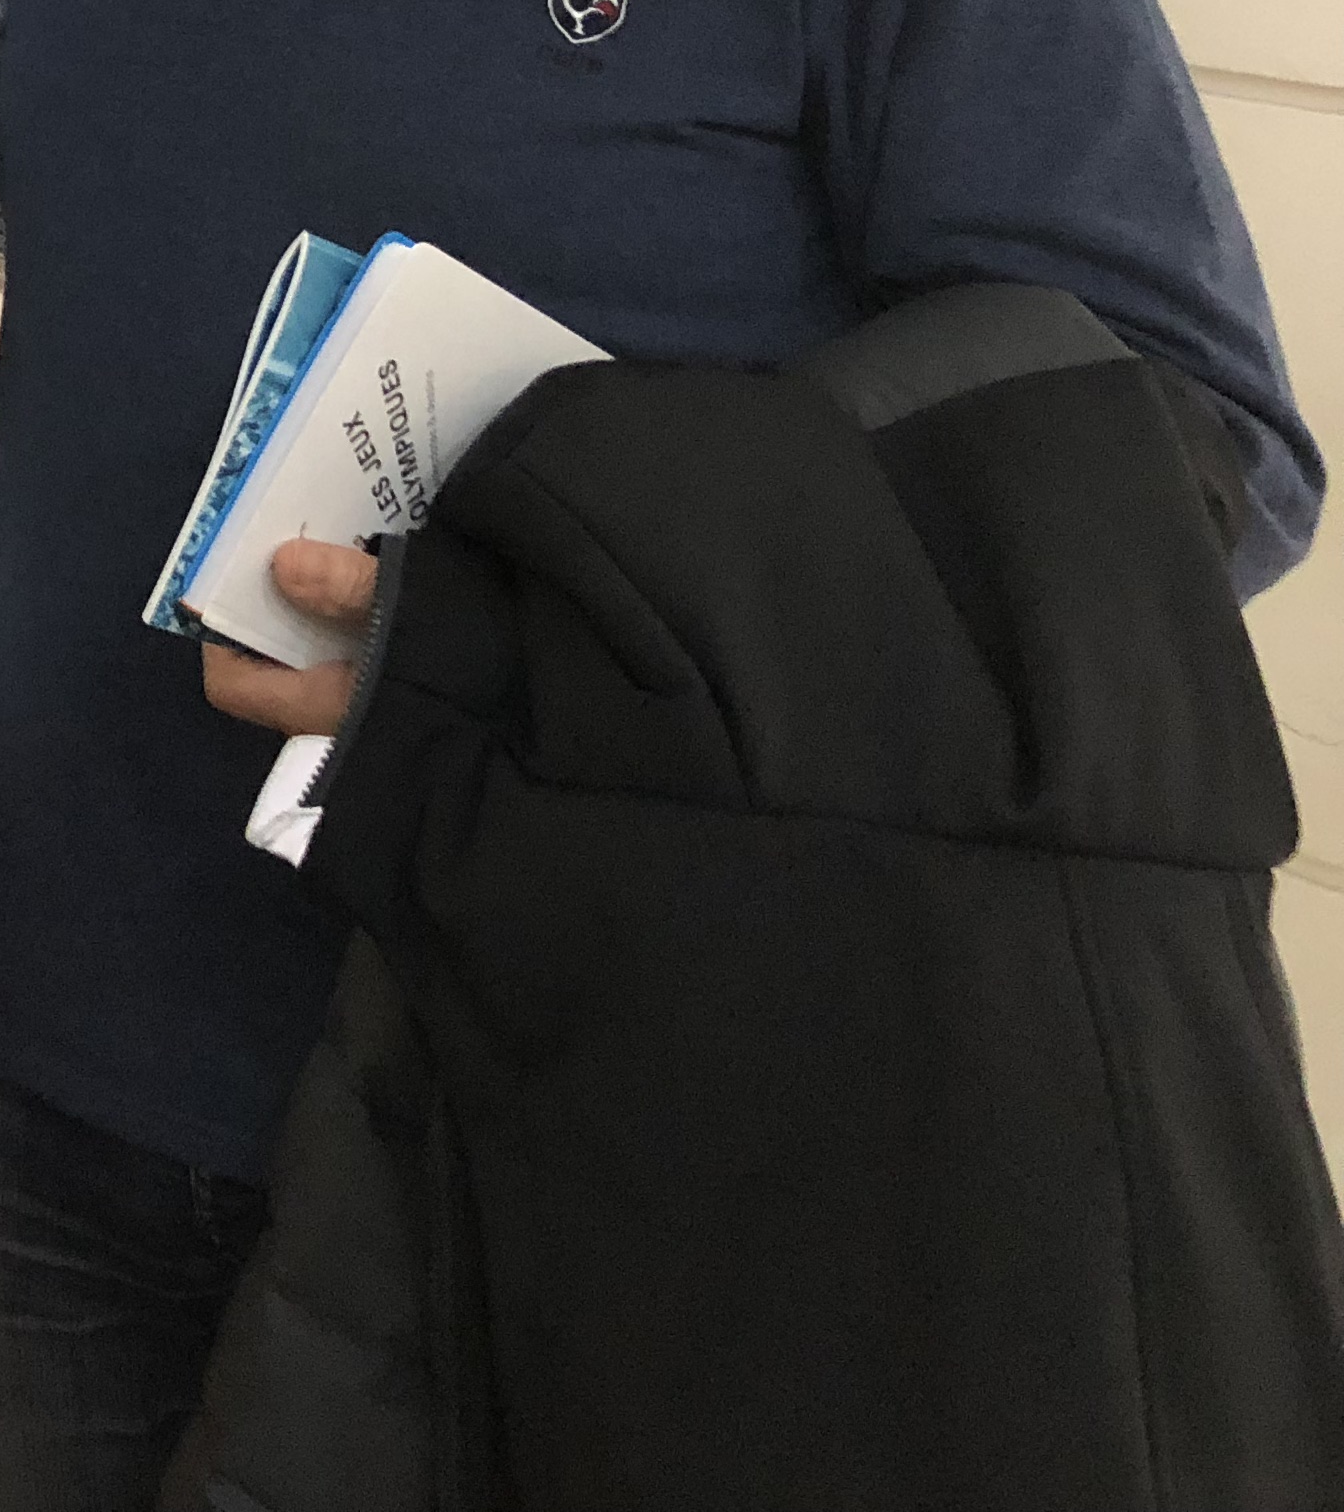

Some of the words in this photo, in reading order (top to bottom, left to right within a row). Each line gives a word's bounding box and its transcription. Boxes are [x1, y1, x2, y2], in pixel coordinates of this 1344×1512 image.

[342, 410, 382, 473] JEUX
[378, 359, 428, 522] OLYMPIQUES
[371, 475, 403, 524] LES
